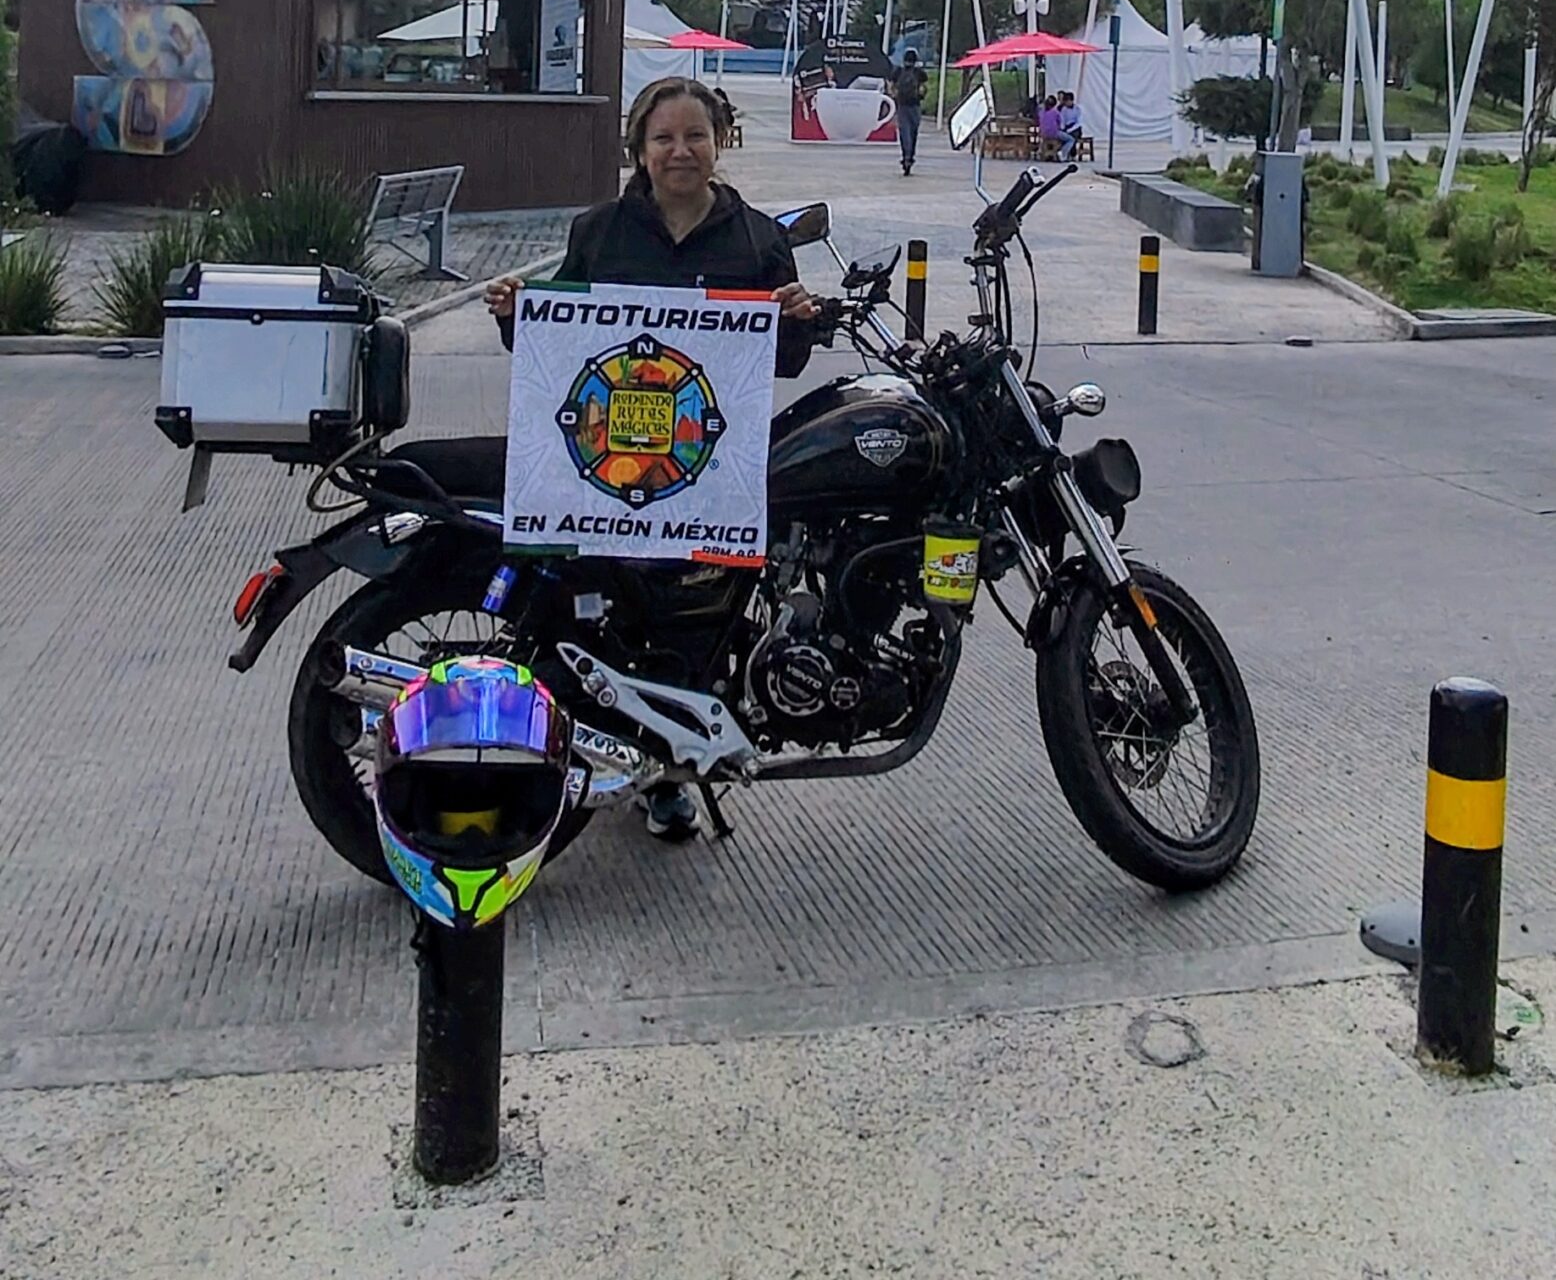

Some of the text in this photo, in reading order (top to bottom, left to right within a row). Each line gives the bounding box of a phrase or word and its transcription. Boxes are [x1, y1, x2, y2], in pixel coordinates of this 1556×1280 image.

[520, 298, 773, 333] MOTOTURISMO
[636, 342, 654, 354] N
[706, 420, 720, 432] E
[861, 439, 903, 449] VENTO
[629, 490, 645, 502] S
[512, 512, 759, 544] EN ACCIÓN MÉXICO
